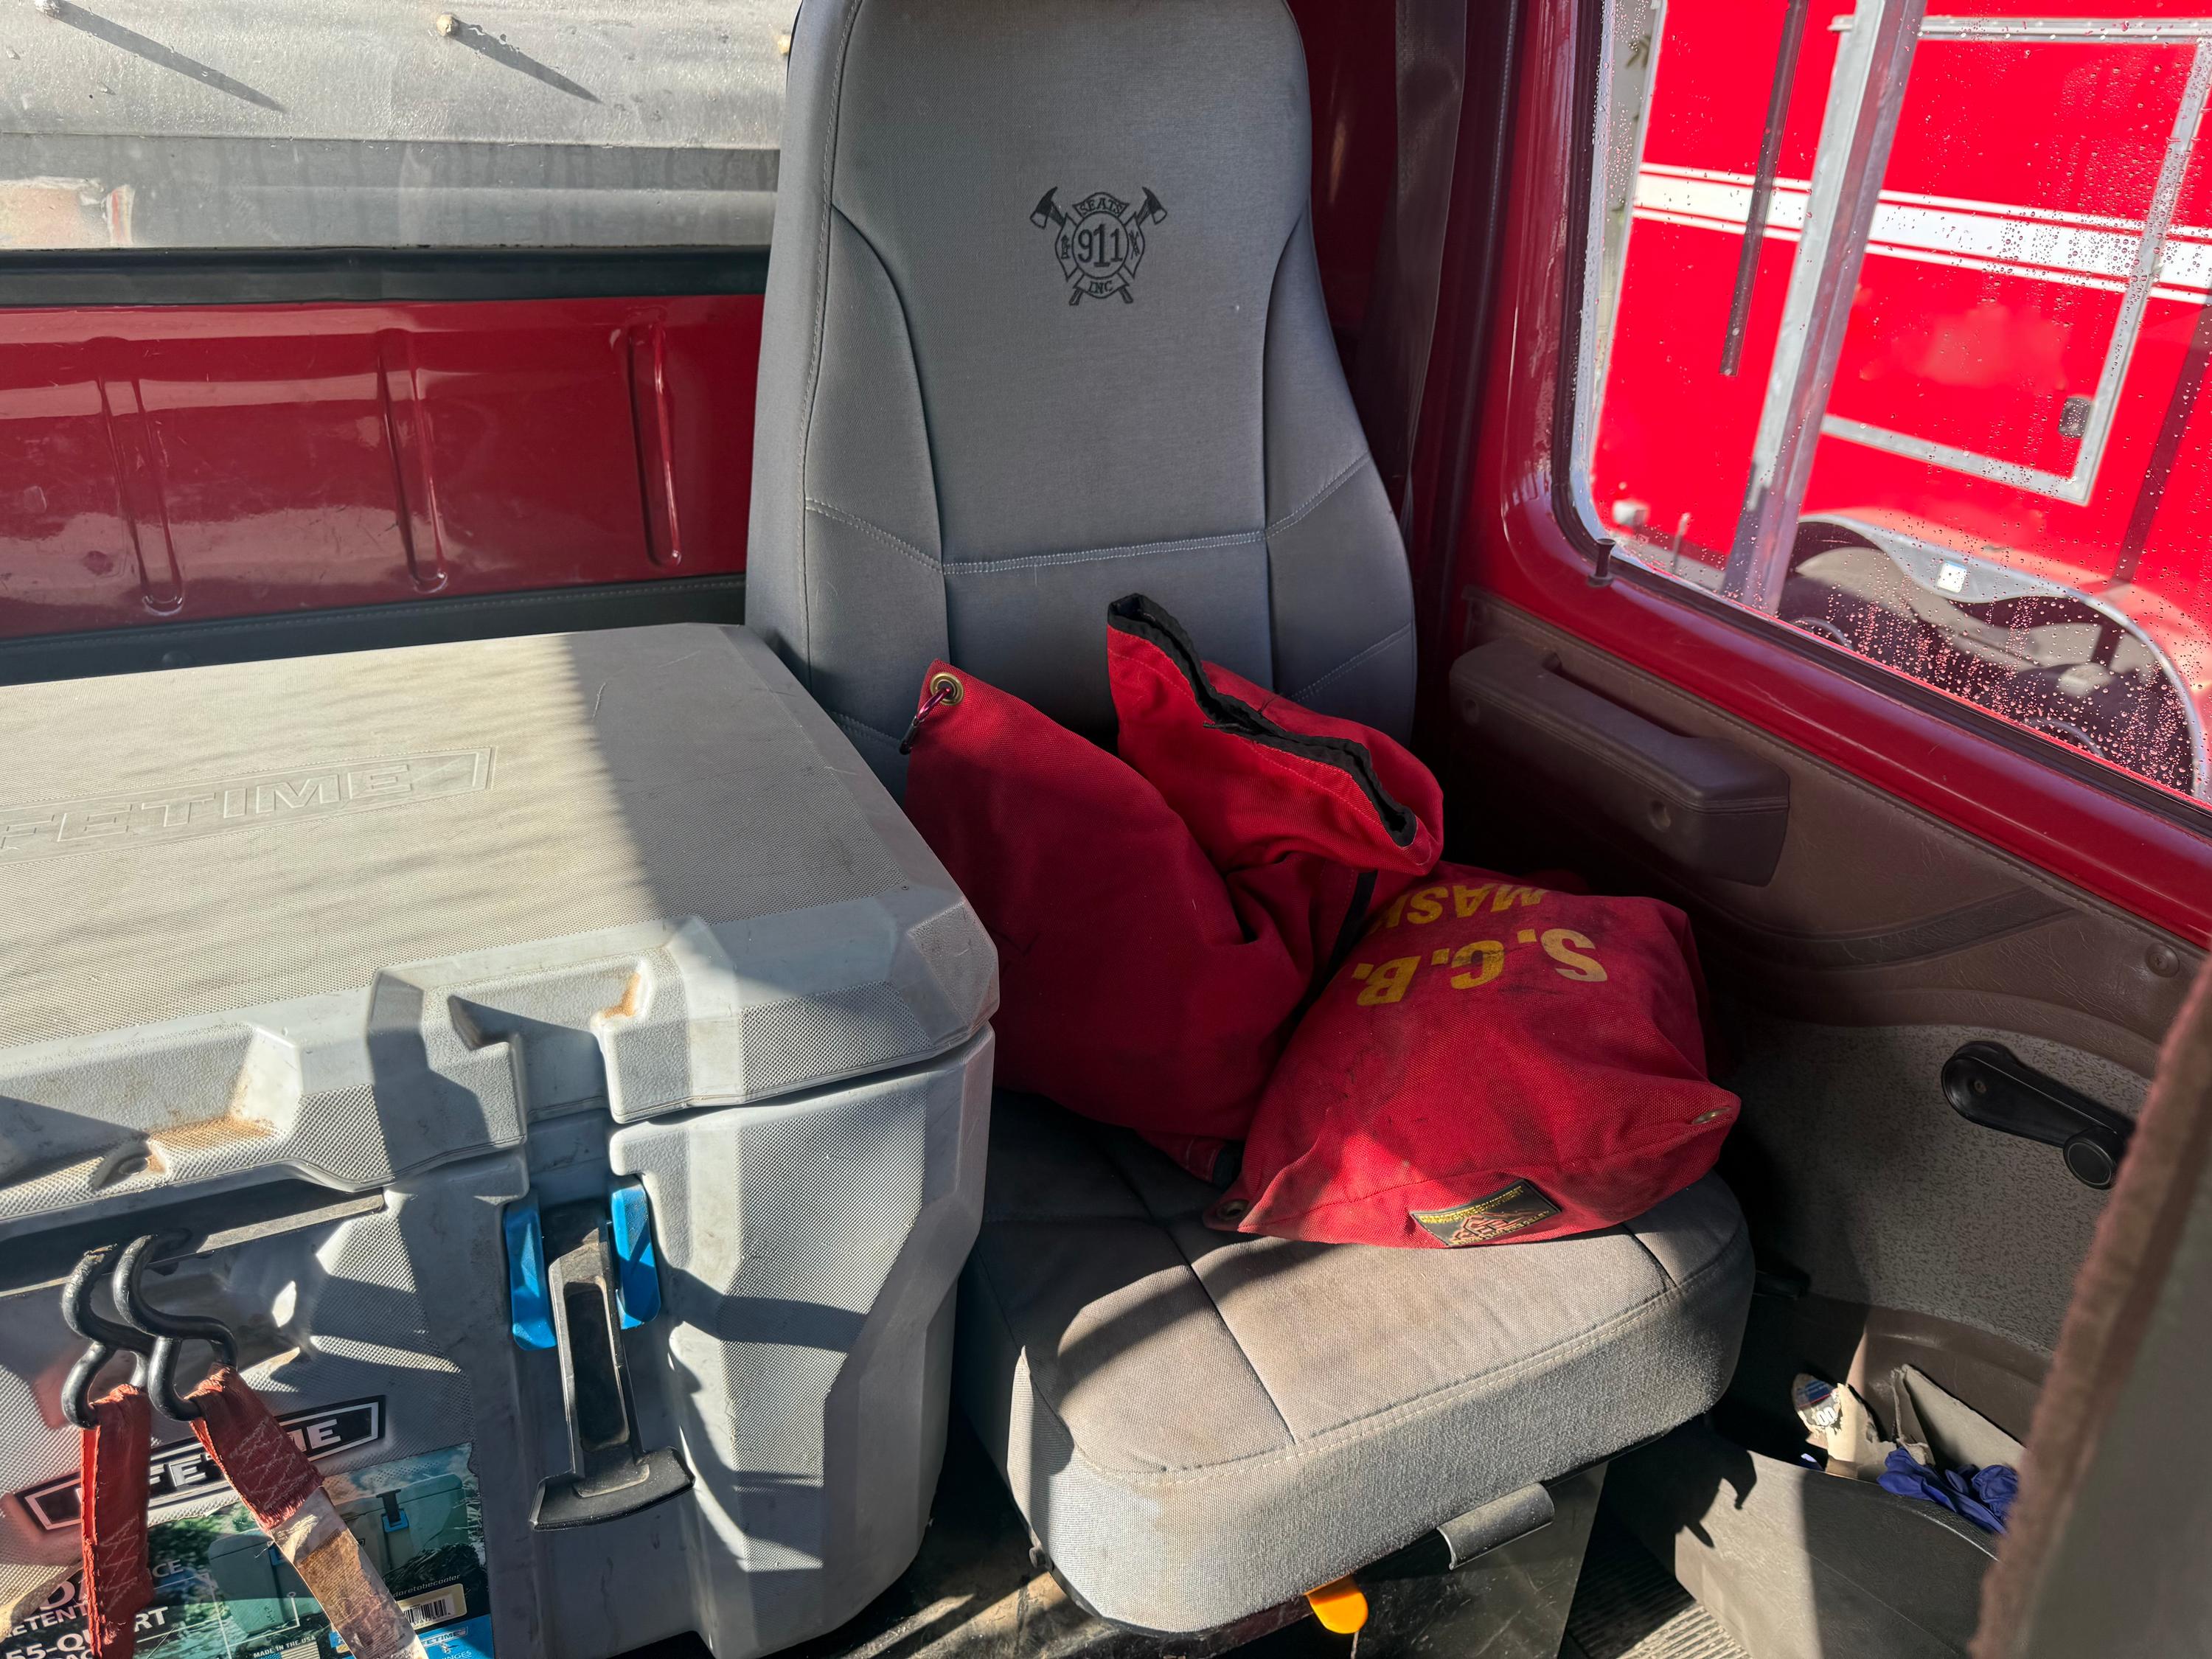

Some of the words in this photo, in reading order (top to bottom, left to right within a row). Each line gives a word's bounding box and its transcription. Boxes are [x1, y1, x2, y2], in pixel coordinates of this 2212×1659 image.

[1079, 198, 1124, 215] SEATS
[1077, 223, 1123, 267] 911
[1088, 280, 1113, 293] INC
[6, 1606, 169, 1659] 55-QRT
[7, 1603, 88, 1638] ETENT
[253, 1649, 274, 1658] MADE
[286, 1641, 299, 1649] THE
[302, 1635, 316, 1644] USA
